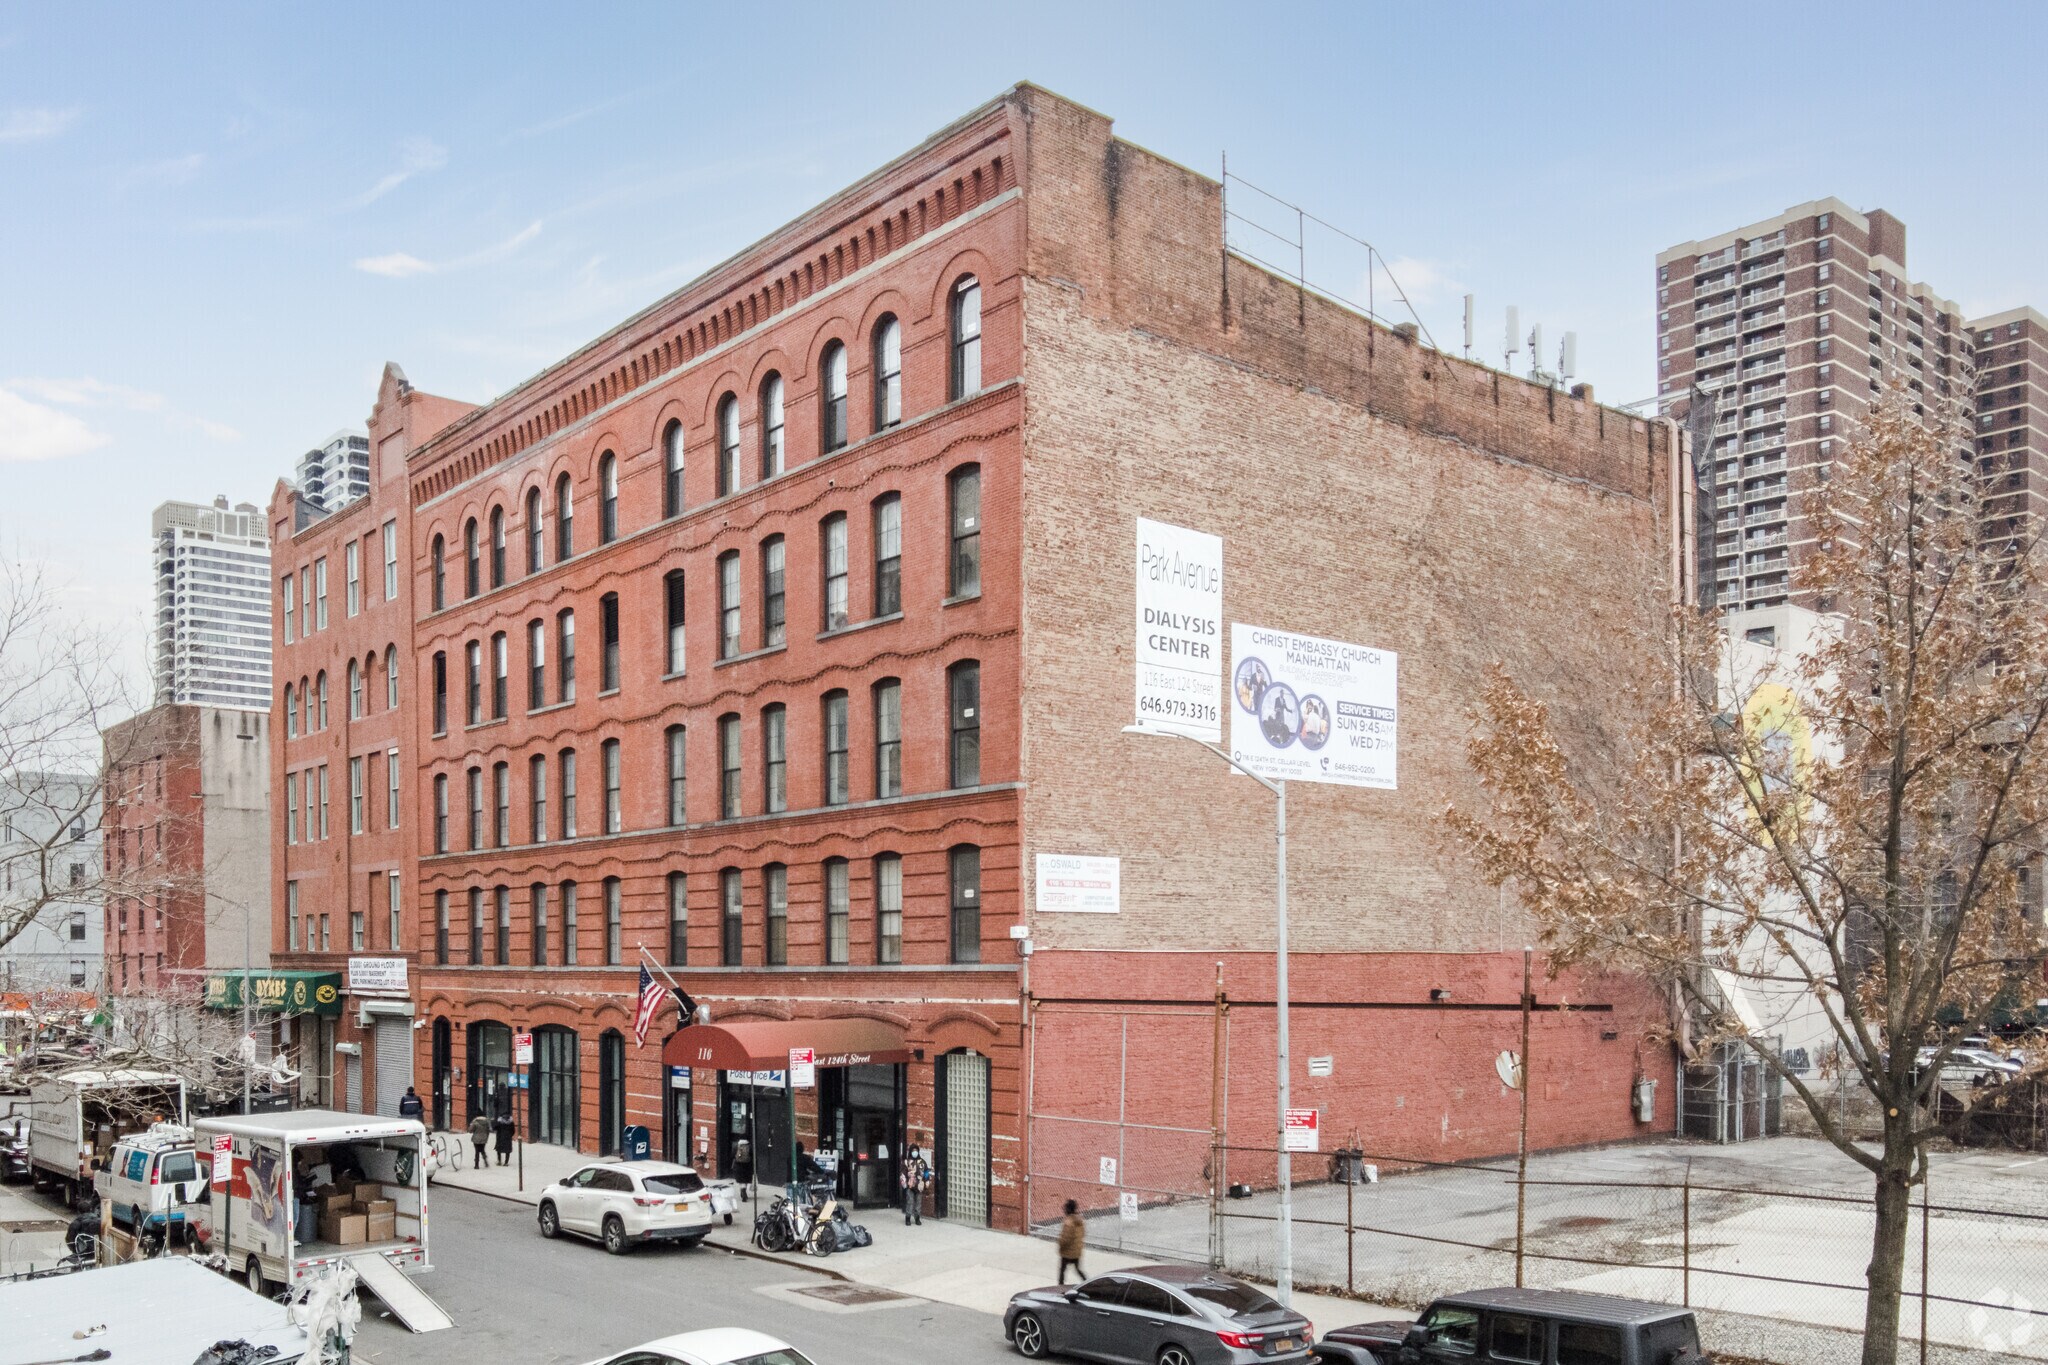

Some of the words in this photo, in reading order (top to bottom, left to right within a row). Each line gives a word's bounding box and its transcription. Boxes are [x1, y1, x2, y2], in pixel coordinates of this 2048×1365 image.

[1142, 543, 1169, 584] Park
[1172, 550, 1218, 594] Avenue
[1144, 607, 1216, 636] DIALYSIS
[1148, 634, 1210, 660] CENTER
[1252, 631, 1289, 649] CHRIST
[1292, 638, 1339, 658] EMBASSY
[1341, 647, 1381, 665] CHURCH
[1286, 651, 1351, 672] MANHATTAN
[1144, 671, 1158, 687] 116
[1160, 673, 1176, 690] East
[1193, 678, 1214, 697] Street
[1140, 696, 1217, 721] 646.979.3316
[1339, 704, 1372, 717] SERVICE
[1373, 708, 1394, 720] TIMES
[1337, 717, 1358, 731] SUN
[1349, 735, 1374, 750] WED
[1050, 859, 1081, 870] OSWALD
[256, 978, 287, 998] DYKES
[698, 1048, 712, 1060] 116
[827, 1053, 849, 1065] 124th
[849, 1053, 871, 1066] Street
